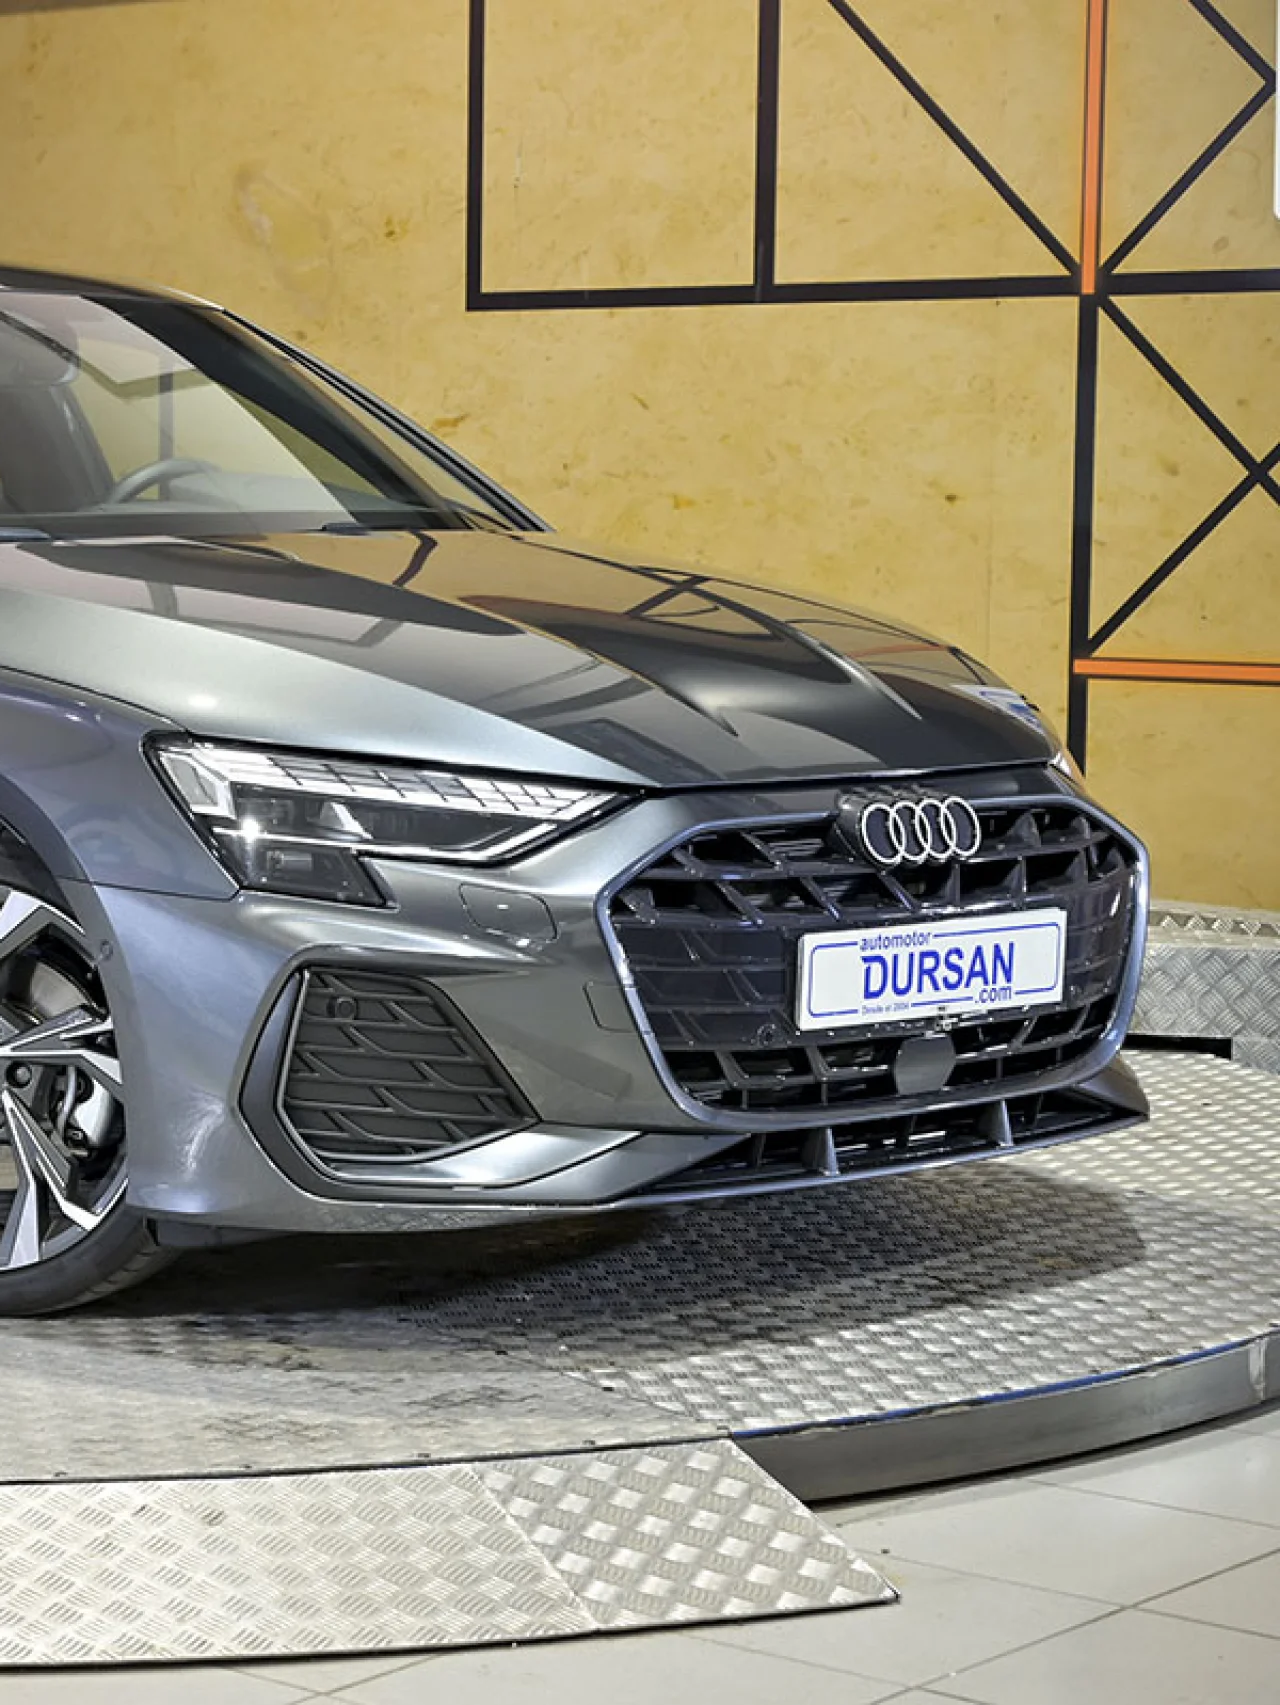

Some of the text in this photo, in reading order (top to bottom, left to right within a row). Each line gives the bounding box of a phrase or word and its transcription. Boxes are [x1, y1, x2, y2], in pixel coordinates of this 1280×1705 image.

[859, 931, 932, 952] automotor
[860, 941, 1014, 1000] DURSAN
[975, 985, 1012, 1004] .com
